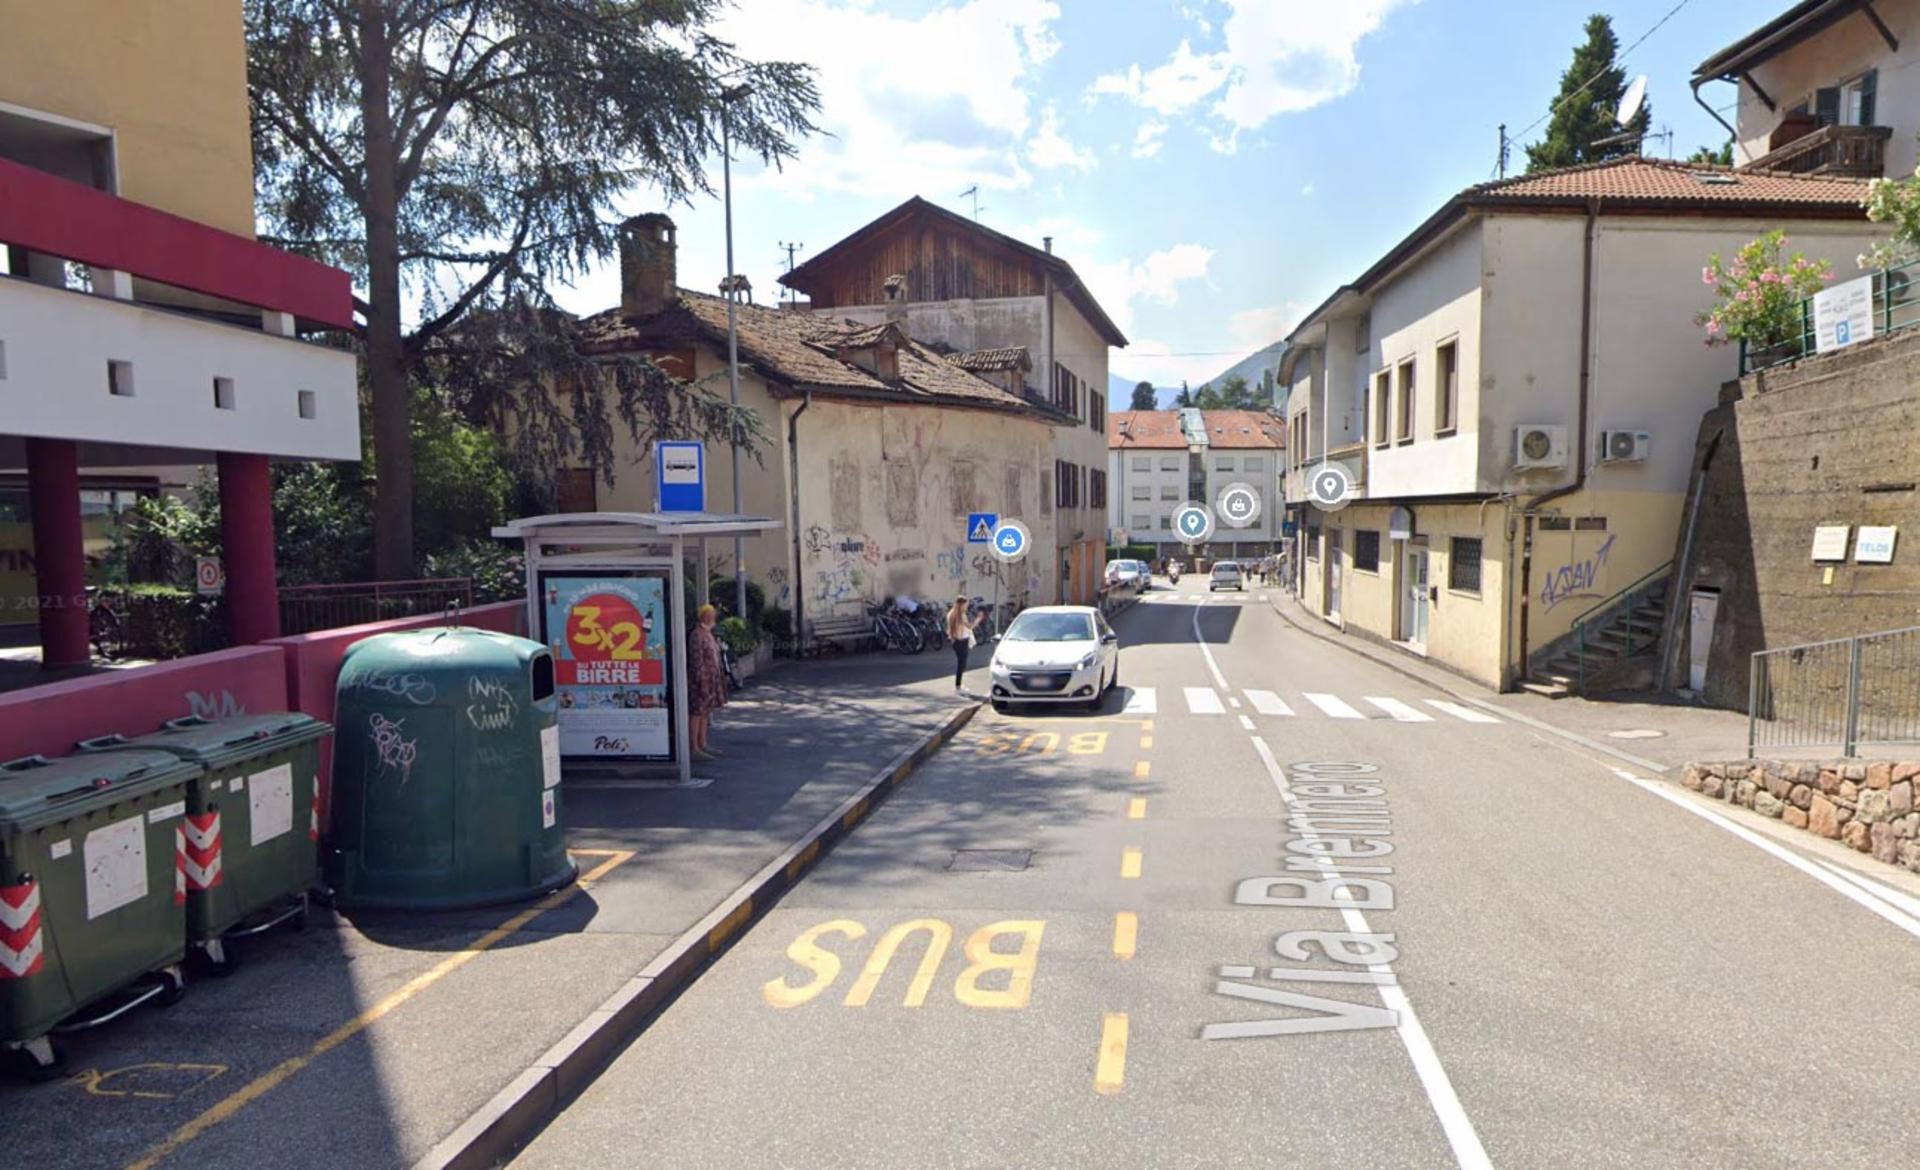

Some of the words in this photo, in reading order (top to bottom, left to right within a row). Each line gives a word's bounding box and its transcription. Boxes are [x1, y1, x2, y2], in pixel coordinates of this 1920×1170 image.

[573, 606, 643, 660] 3x2
[590, 660, 627, 669] TUTTE
[628, 661, 640, 669] LE
[576, 669, 641, 684] BIRRE
[593, 735, 625, 751] Poli
[979, 730, 1109, 755] BUS
[761, 919, 1047, 1010] BUS
